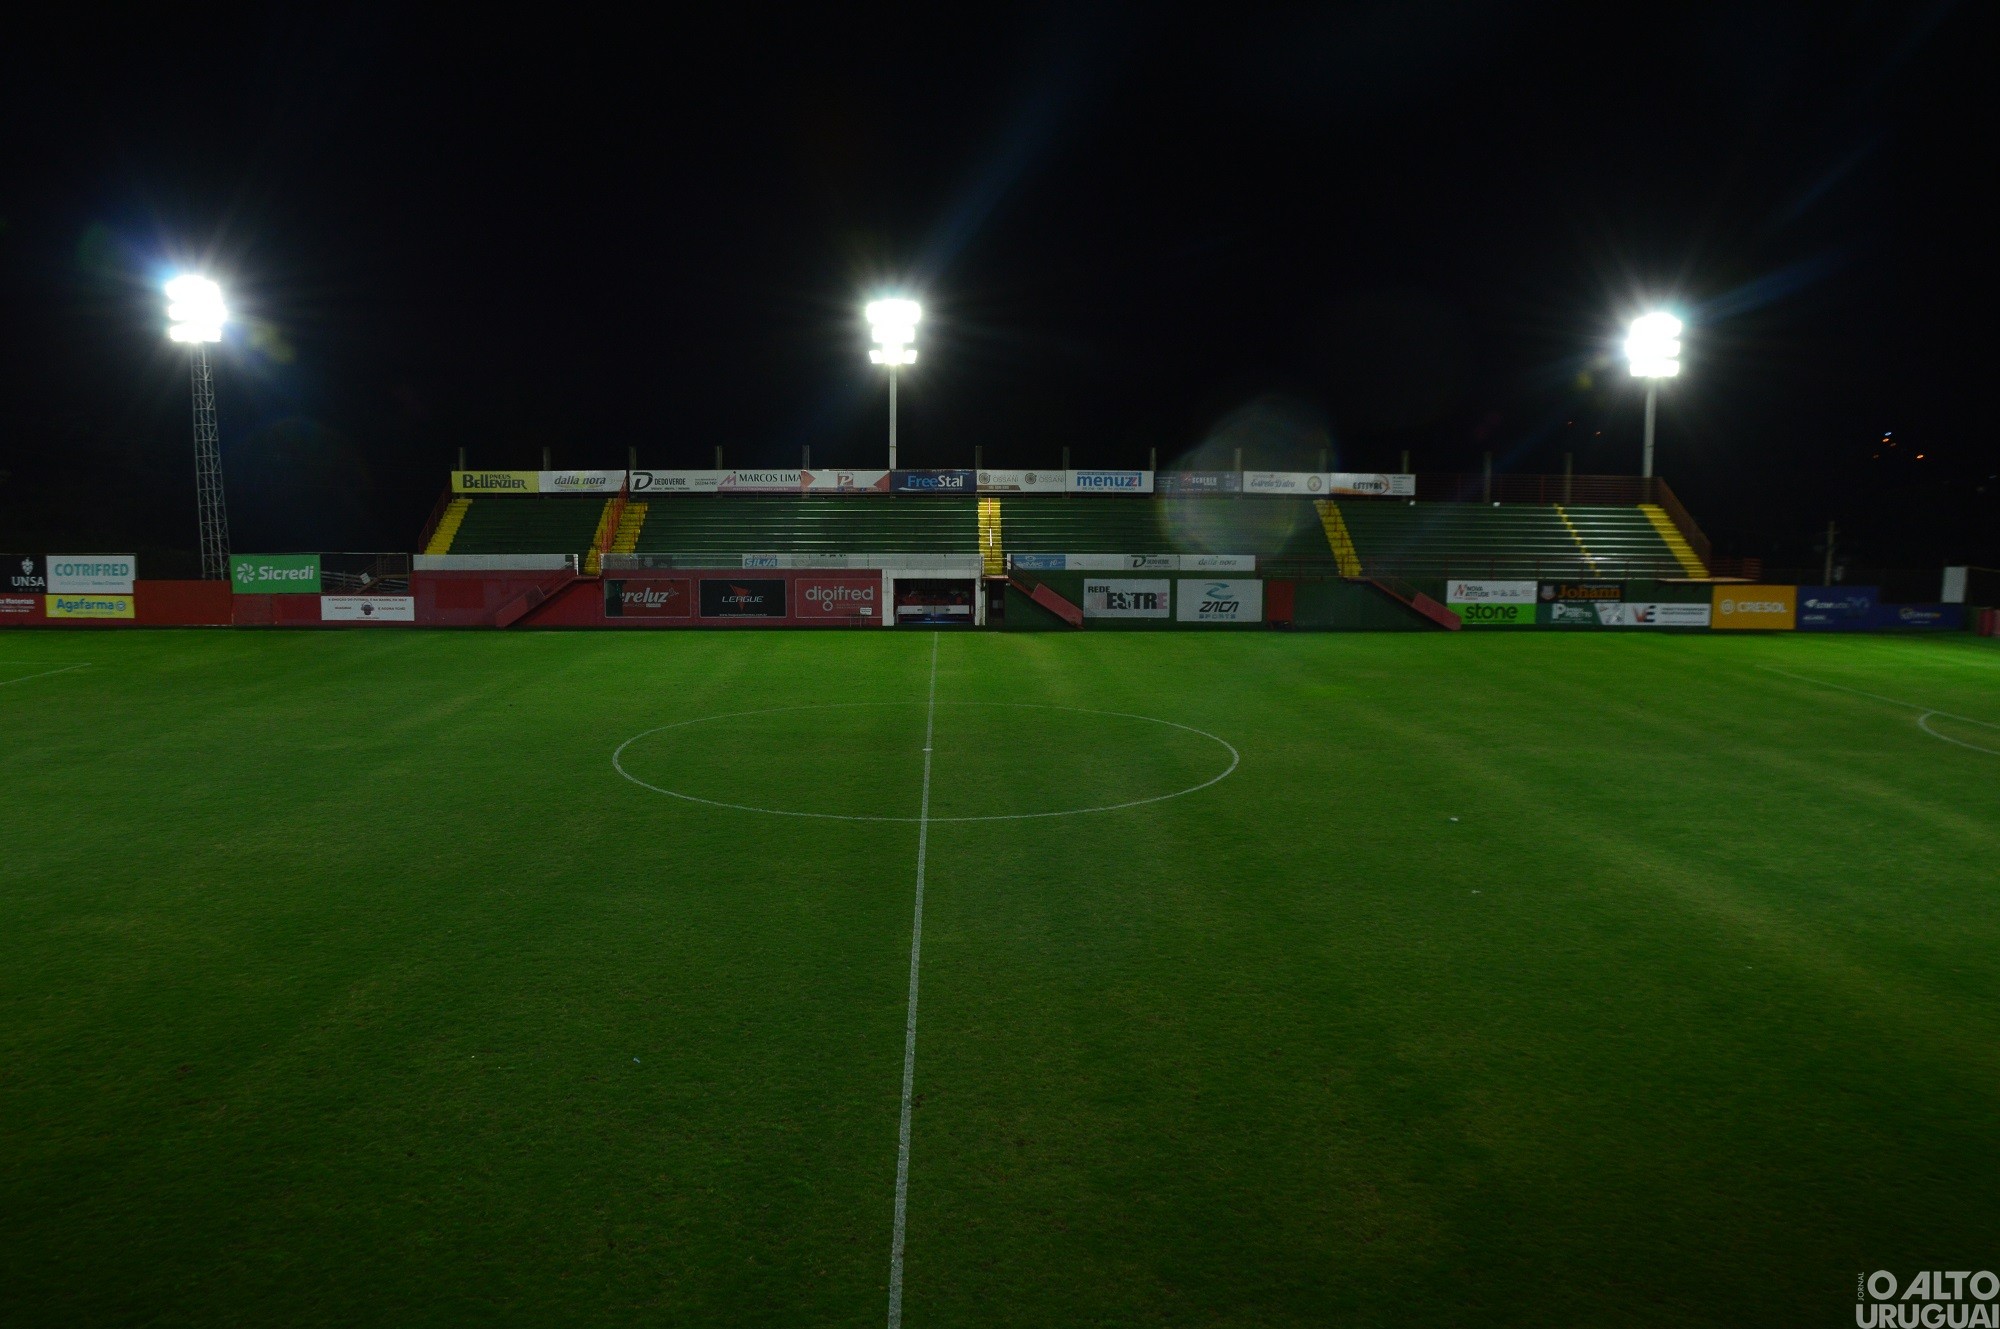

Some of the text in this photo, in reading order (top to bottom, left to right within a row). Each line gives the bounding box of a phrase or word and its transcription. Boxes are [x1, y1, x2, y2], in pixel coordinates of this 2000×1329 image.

[554, 475, 606, 485] dalla nora
[739, 474, 801, 482] MARCOS LIMA
[907, 475, 963, 488] FreeStal
[54, 563, 129, 577] COTRIFRED
[257, 565, 315, 581] Sicredi
[11, 576, 46, 587] UNSA
[621, 587, 669, 603] reluz
[721, 595, 764, 603] LEAGUE
[805, 585, 874, 612] digifred
[56, 598, 114, 612] Agafarma
[1199, 601, 1239, 613] ZACA
[1465, 603, 1518, 619] stone
[1737, 602, 1787, 613] CRESOL
